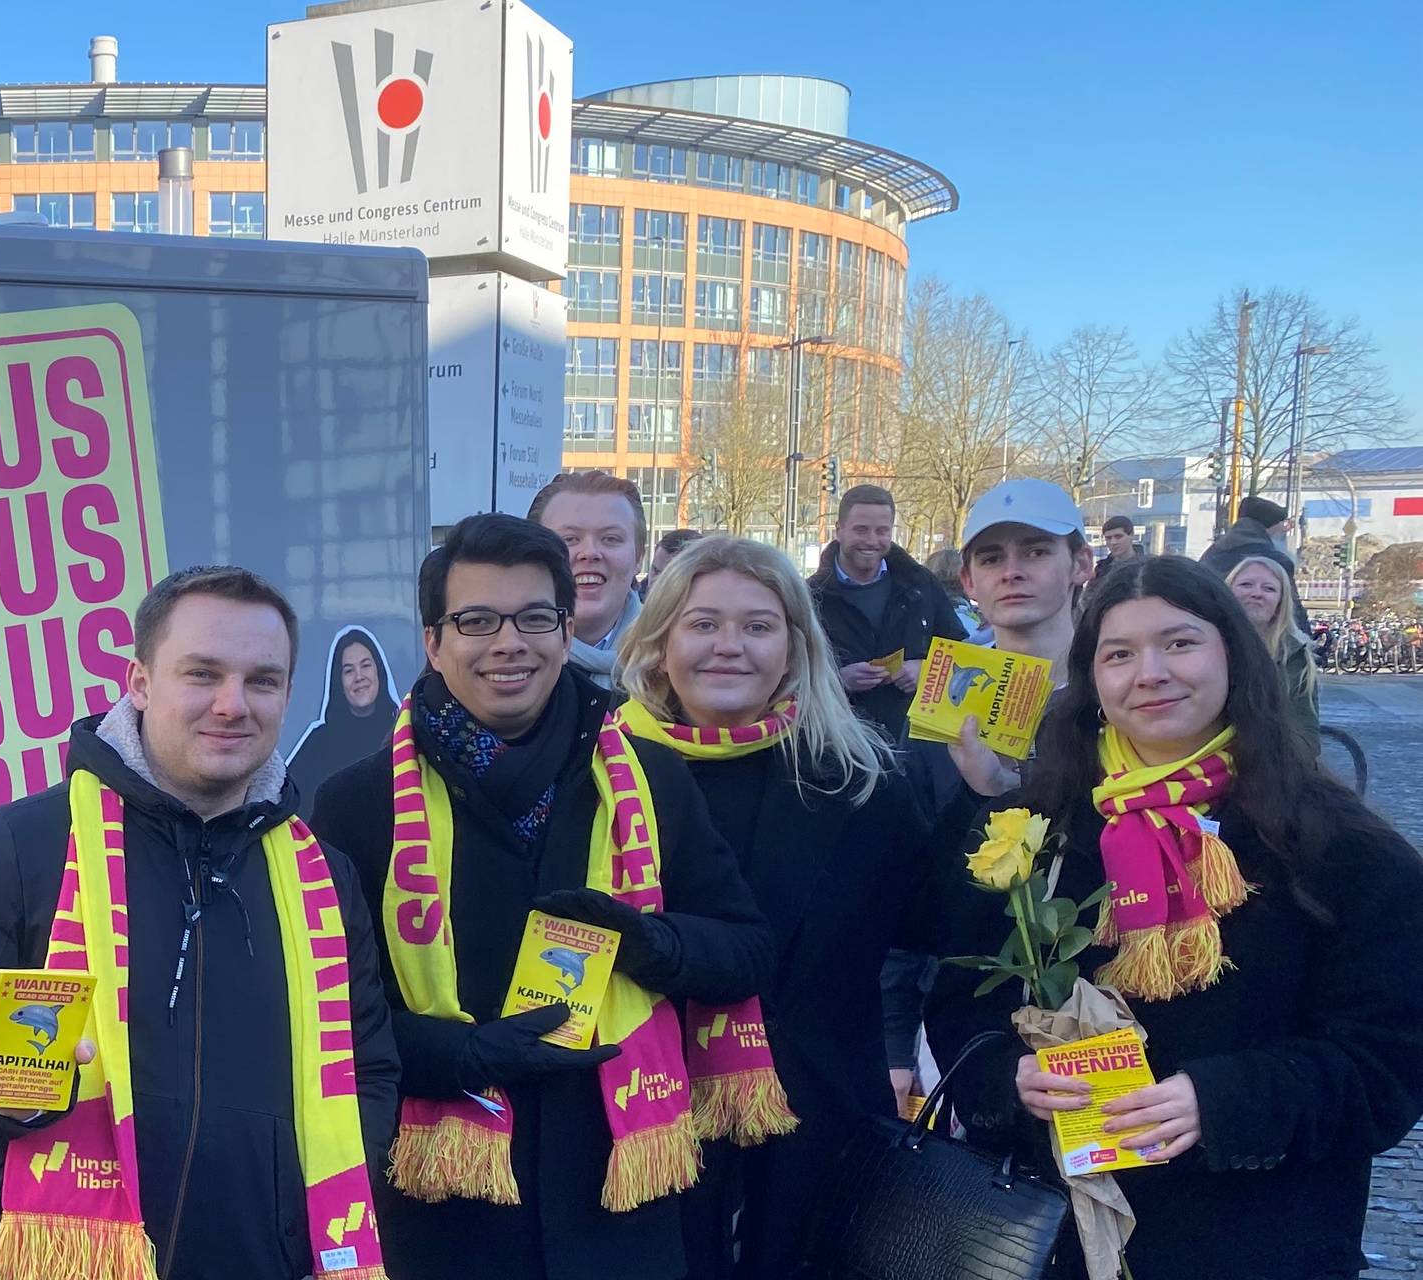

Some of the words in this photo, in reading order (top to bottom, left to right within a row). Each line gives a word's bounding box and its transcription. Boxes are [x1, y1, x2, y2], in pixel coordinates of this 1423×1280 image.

[284, 212, 325, 228] Messe
[328, 208, 353, 224] und
[357, 202, 419, 221] Congress
[423, 197, 482, 213] Centrum
[323, 231, 355, 245] Halle
[359, 222, 440, 244] Münsterland
[428, 363, 462, 379] rum
[511, 380, 527, 399] Forum
[510, 406, 543, 429] Messehallen
[508, 444, 527, 462] Forum
[920, 650, 944, 704] WANTED
[987, 657, 1016, 726] KAPITALHAI
[544, 918, 607, 945] WANTED
[577, 940, 598, 952] ALIVE
[14, 978, 82, 993] WANTED
[16, 992, 37, 1000] DEAD
[50, 995, 73, 1003] ALIVE
[731, 1020, 766, 1038] jung
[739, 1034, 770, 1049] libe
[1046, 1043, 1140, 1062] WACHSTUMS
[1048, 1053, 1144, 1077] WENDE
[70, 1152, 122, 1175] junge
[77, 1171, 126, 1190] liber
